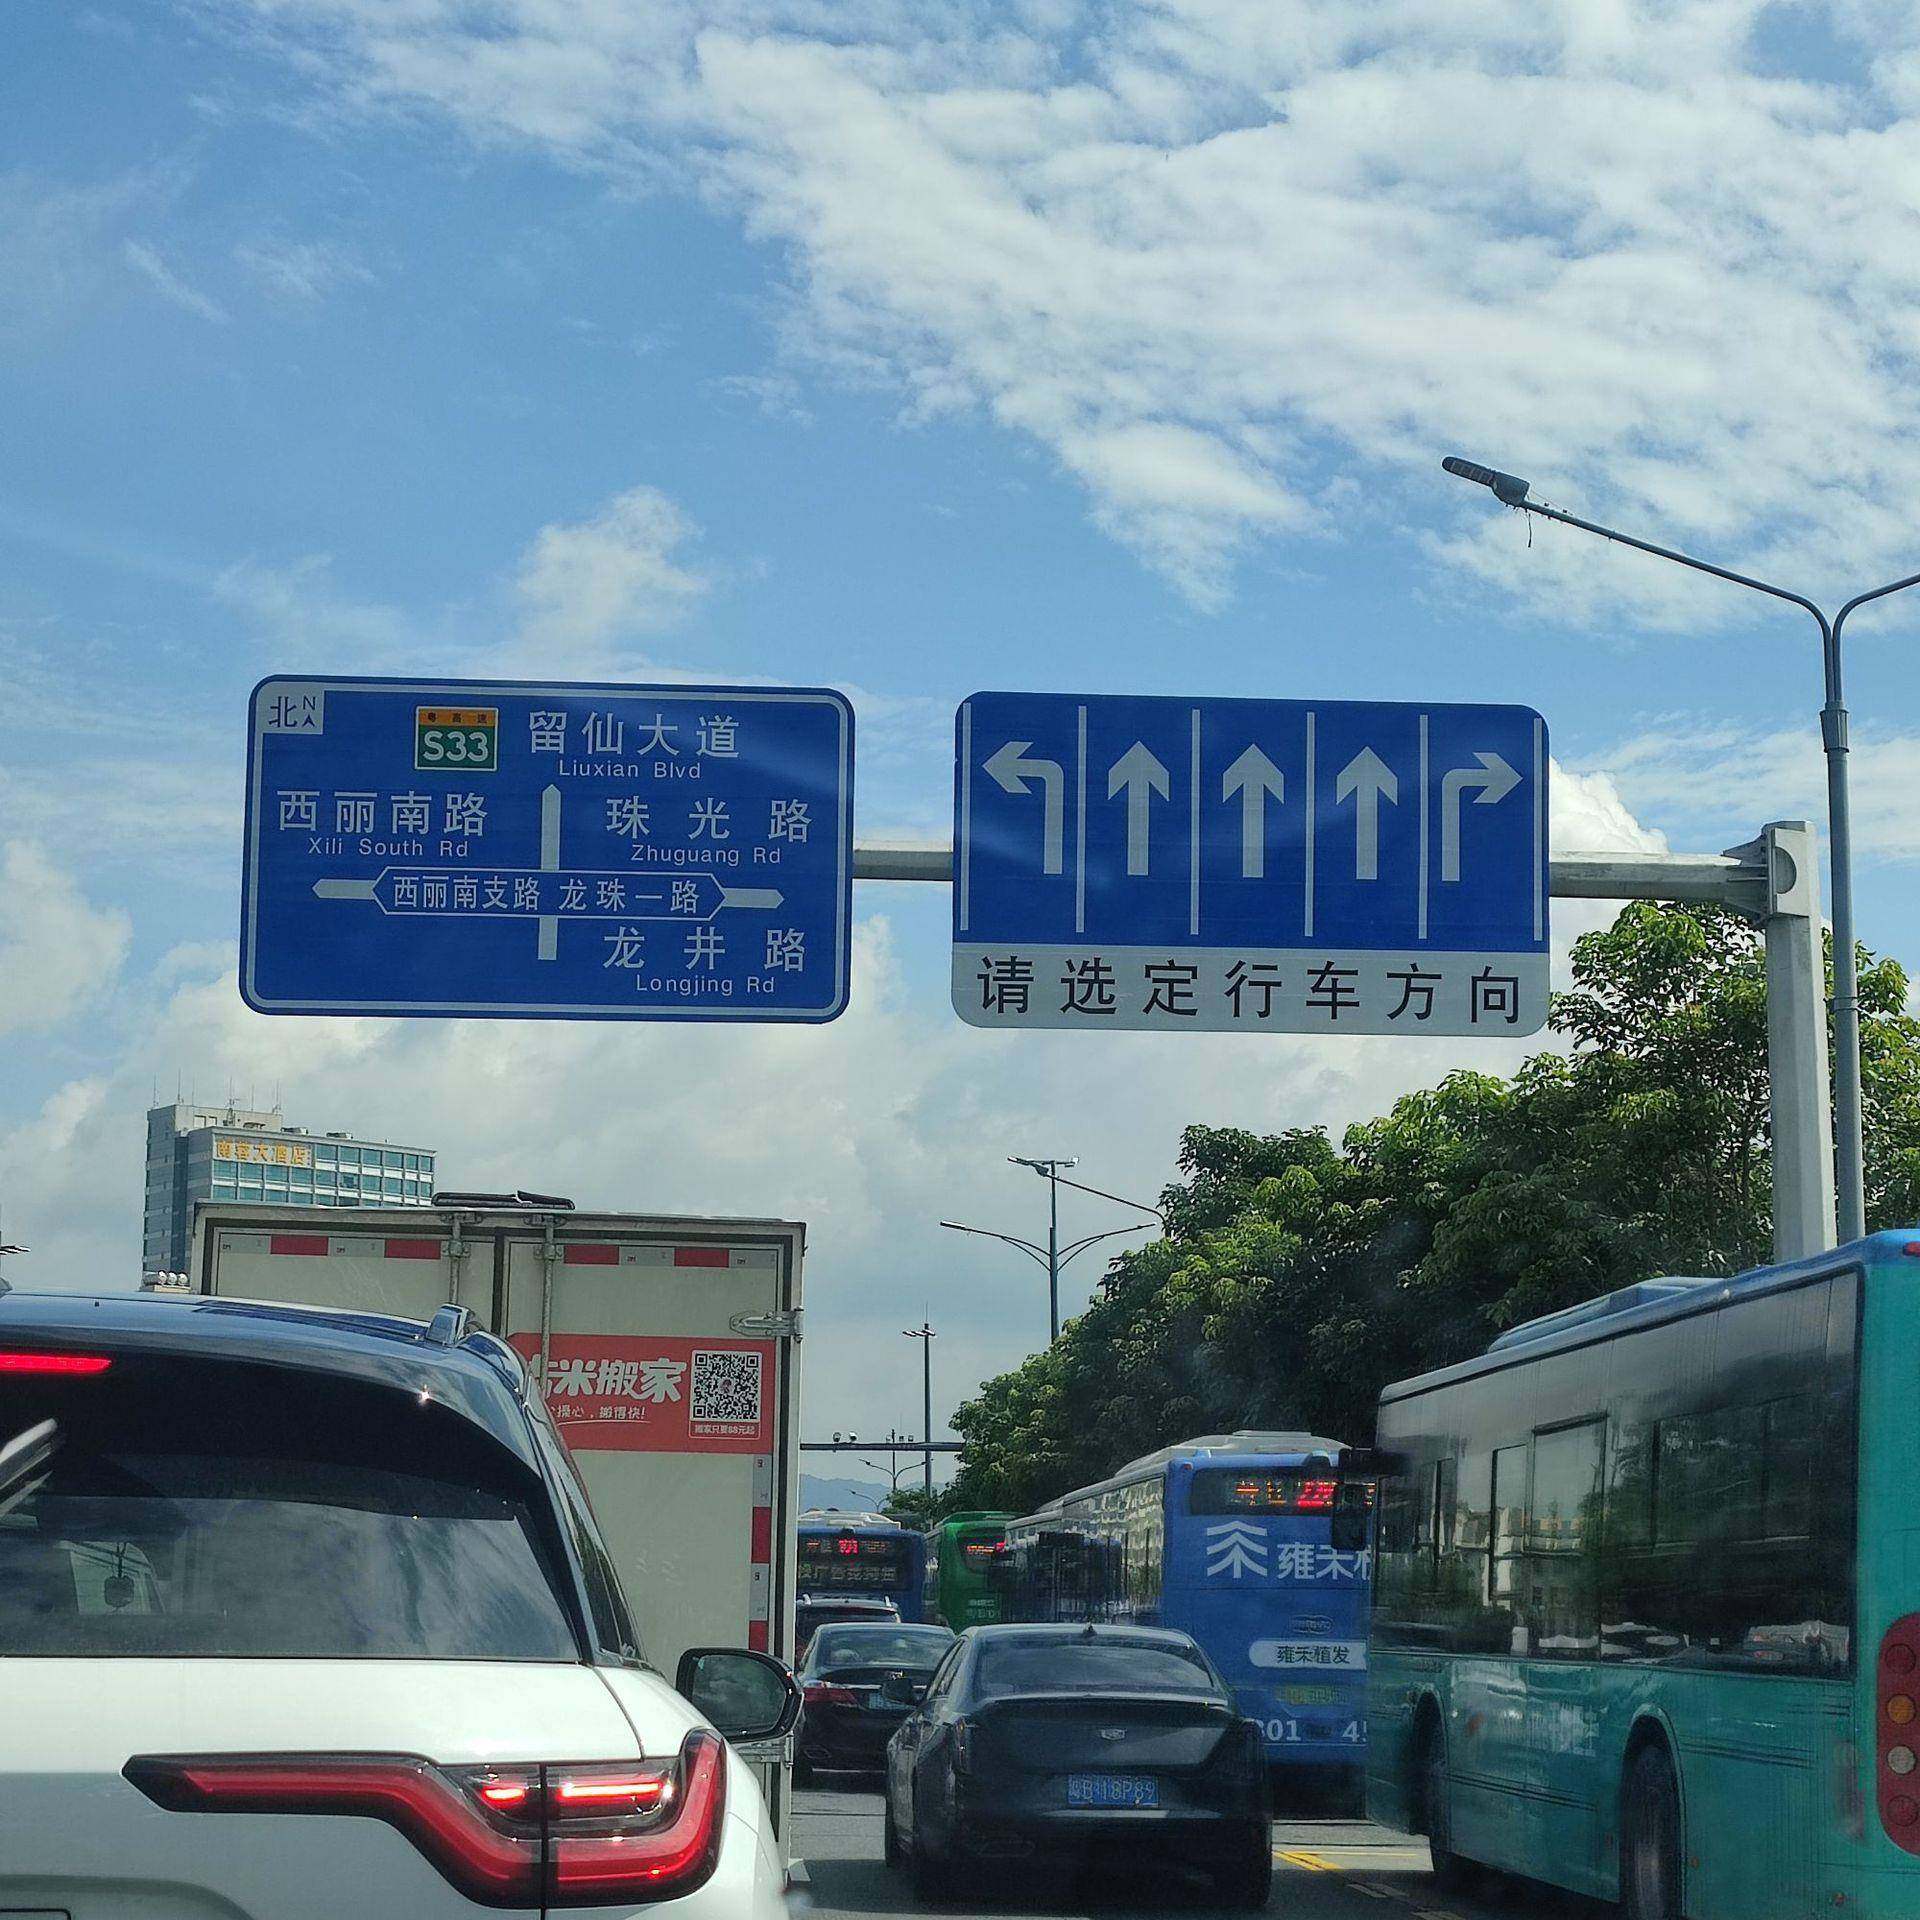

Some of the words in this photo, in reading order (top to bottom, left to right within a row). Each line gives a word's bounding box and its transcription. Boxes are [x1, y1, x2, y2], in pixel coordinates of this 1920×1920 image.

[268, 695, 298, 728] 北
[302, 695, 316, 711] N
[427, 711, 488, 724] 粤高速
[423, 730, 489, 762] S33
[529, 710, 740, 759] 留仙大道
[558, 759, 639, 778] Liuxian
[653, 761, 702, 779] Blvd
[277, 790, 488, 836] 西丽南路
[606, 795, 813, 843] 珠光路
[308, 837, 343, 855] Xili
[358, 838, 424, 857] South
[439, 840, 469, 857] Rd
[631, 844, 740, 867] Zhuguang
[753, 847, 781, 864] Rd
[393, 874, 541, 911] 西丽南支路
[558, 877, 700, 914] 龙珠一路
[602, 926, 806, 973] 龙井路
[636, 974, 734, 997] Longjing
[747, 976, 775, 994] Rd
[977, 955, 1521, 1026] 请选定行车方向
[1276, 1645, 1351, 1665] 雍禾植发
